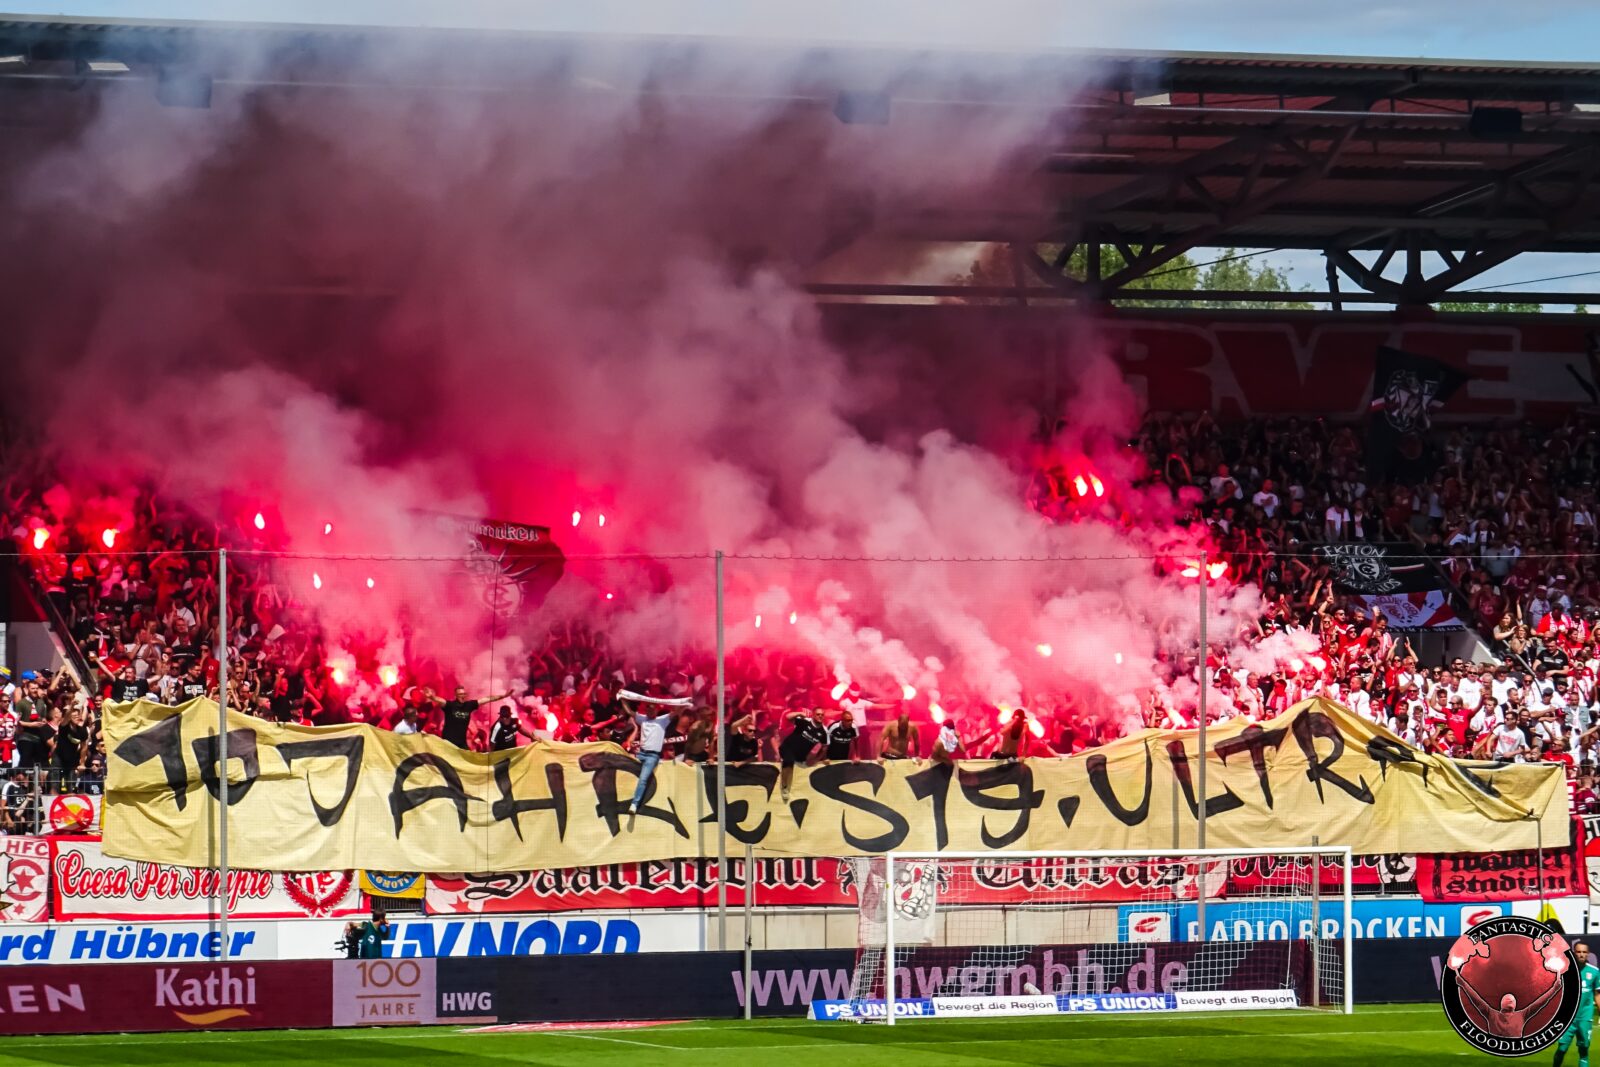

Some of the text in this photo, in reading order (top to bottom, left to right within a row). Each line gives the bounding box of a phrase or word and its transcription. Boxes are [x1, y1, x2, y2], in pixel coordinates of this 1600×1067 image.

[6, 840, 49, 857] HFC
[132, 861, 181, 900] Per
[467, 921, 641, 958] NORD
[1187, 916, 1446, 941] RADIO BROCKEN
[0, 925, 256, 961] rd Hübner
[155, 966, 257, 1006] Kathi
[356, 960, 421, 988] 100
[0, 984, 86, 1013] EN
[360, 1001, 416, 1016] JAHRE
[442, 991, 492, 1012] HWG
[825, 993, 1295, 1017] PS UNON bewegt die Region PS UNION bewegt die Region
